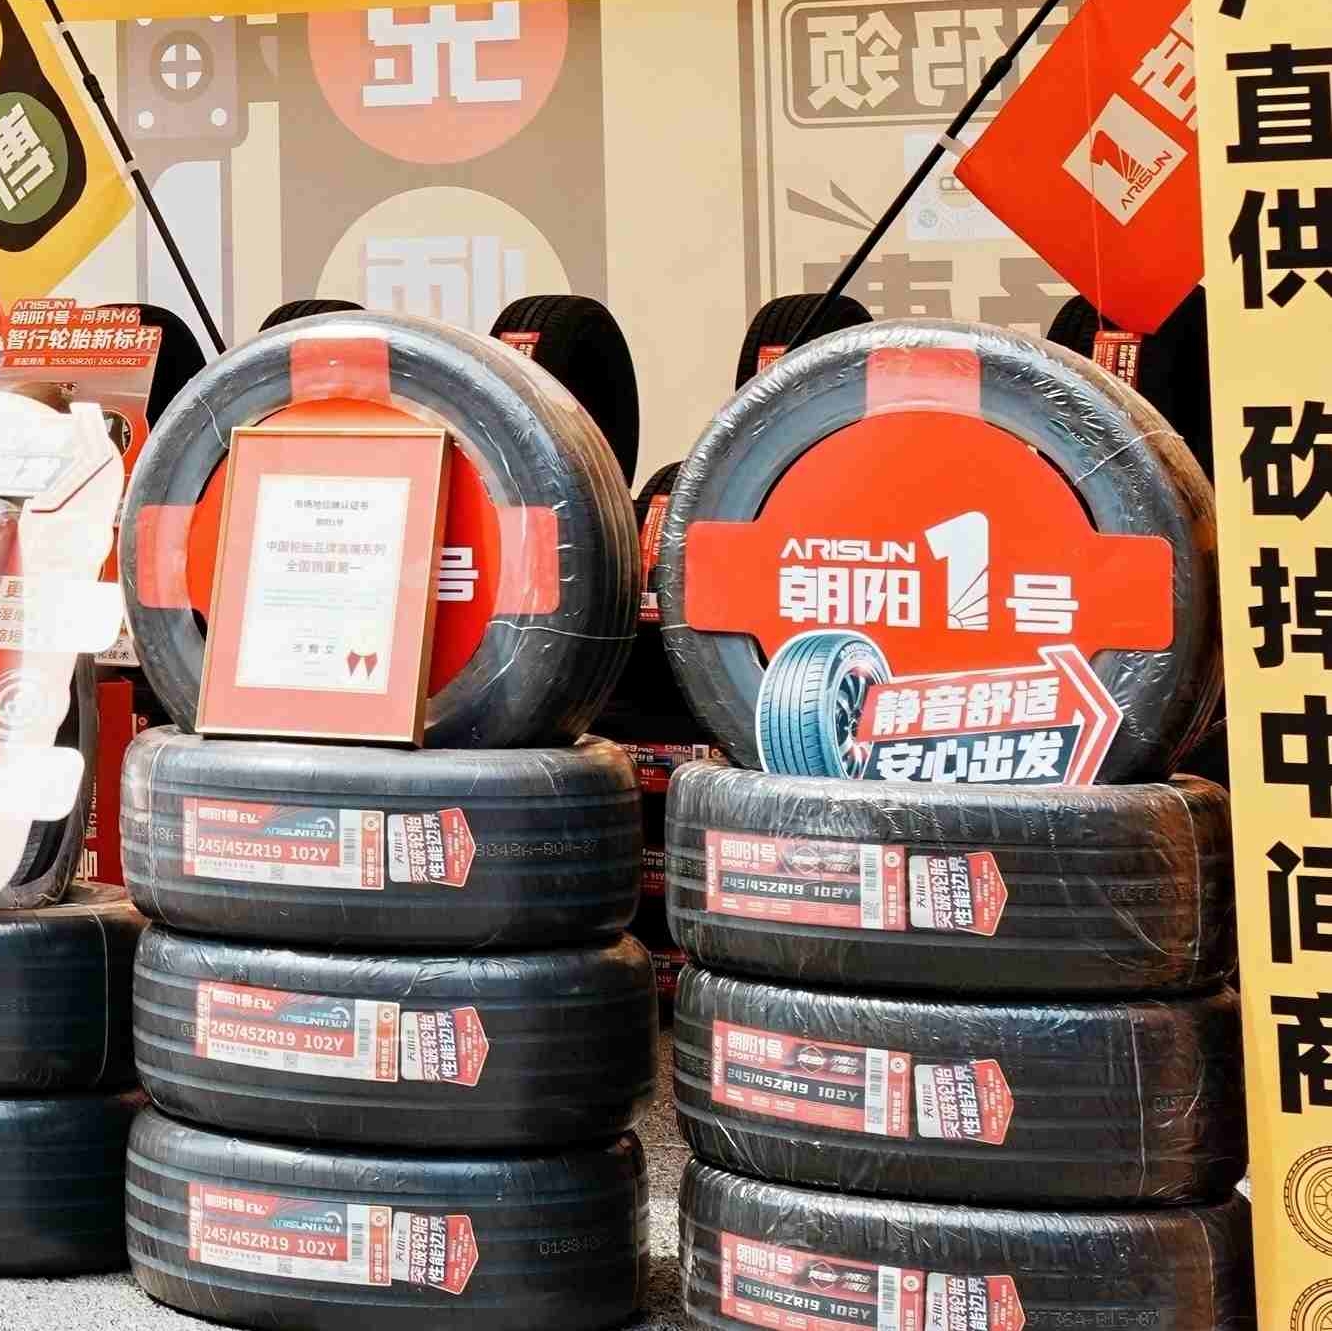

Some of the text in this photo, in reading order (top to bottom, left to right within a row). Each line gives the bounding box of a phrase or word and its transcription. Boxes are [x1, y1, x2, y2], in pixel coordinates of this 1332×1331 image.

[1120, 150, 1173, 211] ARISUN
[6, 328, 159, 351] 智行轮胎新标杆
[777, 511, 1079, 634] 朝阳1号
[780, 539, 916, 563] ARISUN
[873, 677, 1060, 736] 静音舒适
[877, 725, 1065, 784] 安心出发
[197, 837, 330, 862] 245/45ZR19 102Y
[813, 884, 855, 899] 102Y
[929, 858, 954, 930] 突破轮胎
[947, 856, 974, 926] 性能边界
[210, 1019, 345, 1052] 245/45ZR19 102Y
[419, 1013, 440, 1081] 突破轮胎
[437, 1010, 459, 1078] 性能边界
[727, 1067, 860, 1103] 245/45ZR19 102Y
[939, 1067, 961, 1140] 突破轮胎
[958, 1062, 983, 1136] 性能边界
[203, 1223, 337, 1257] 245/45ZR19 102Y
[428, 1215, 447, 1283] 性能边界
[827, 1300, 872, 1319] 102Y
